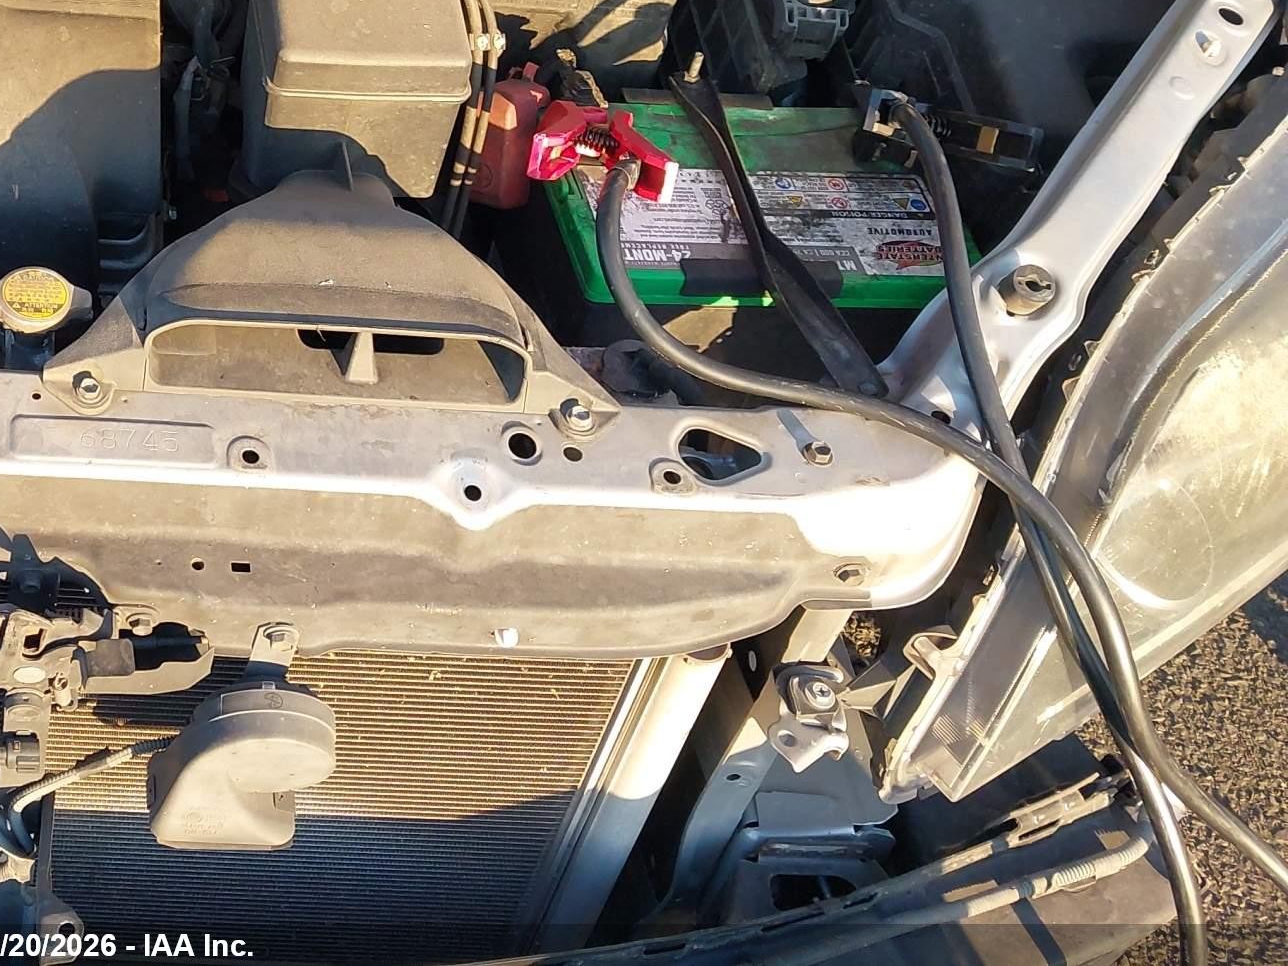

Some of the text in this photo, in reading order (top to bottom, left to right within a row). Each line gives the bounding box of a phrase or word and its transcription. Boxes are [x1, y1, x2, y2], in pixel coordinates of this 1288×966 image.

[867, 227, 932, 236] AUTOMOTIVE
[624, 248, 691, 262] 24-MONT
[876, 253, 944, 261] NTERSTATE
